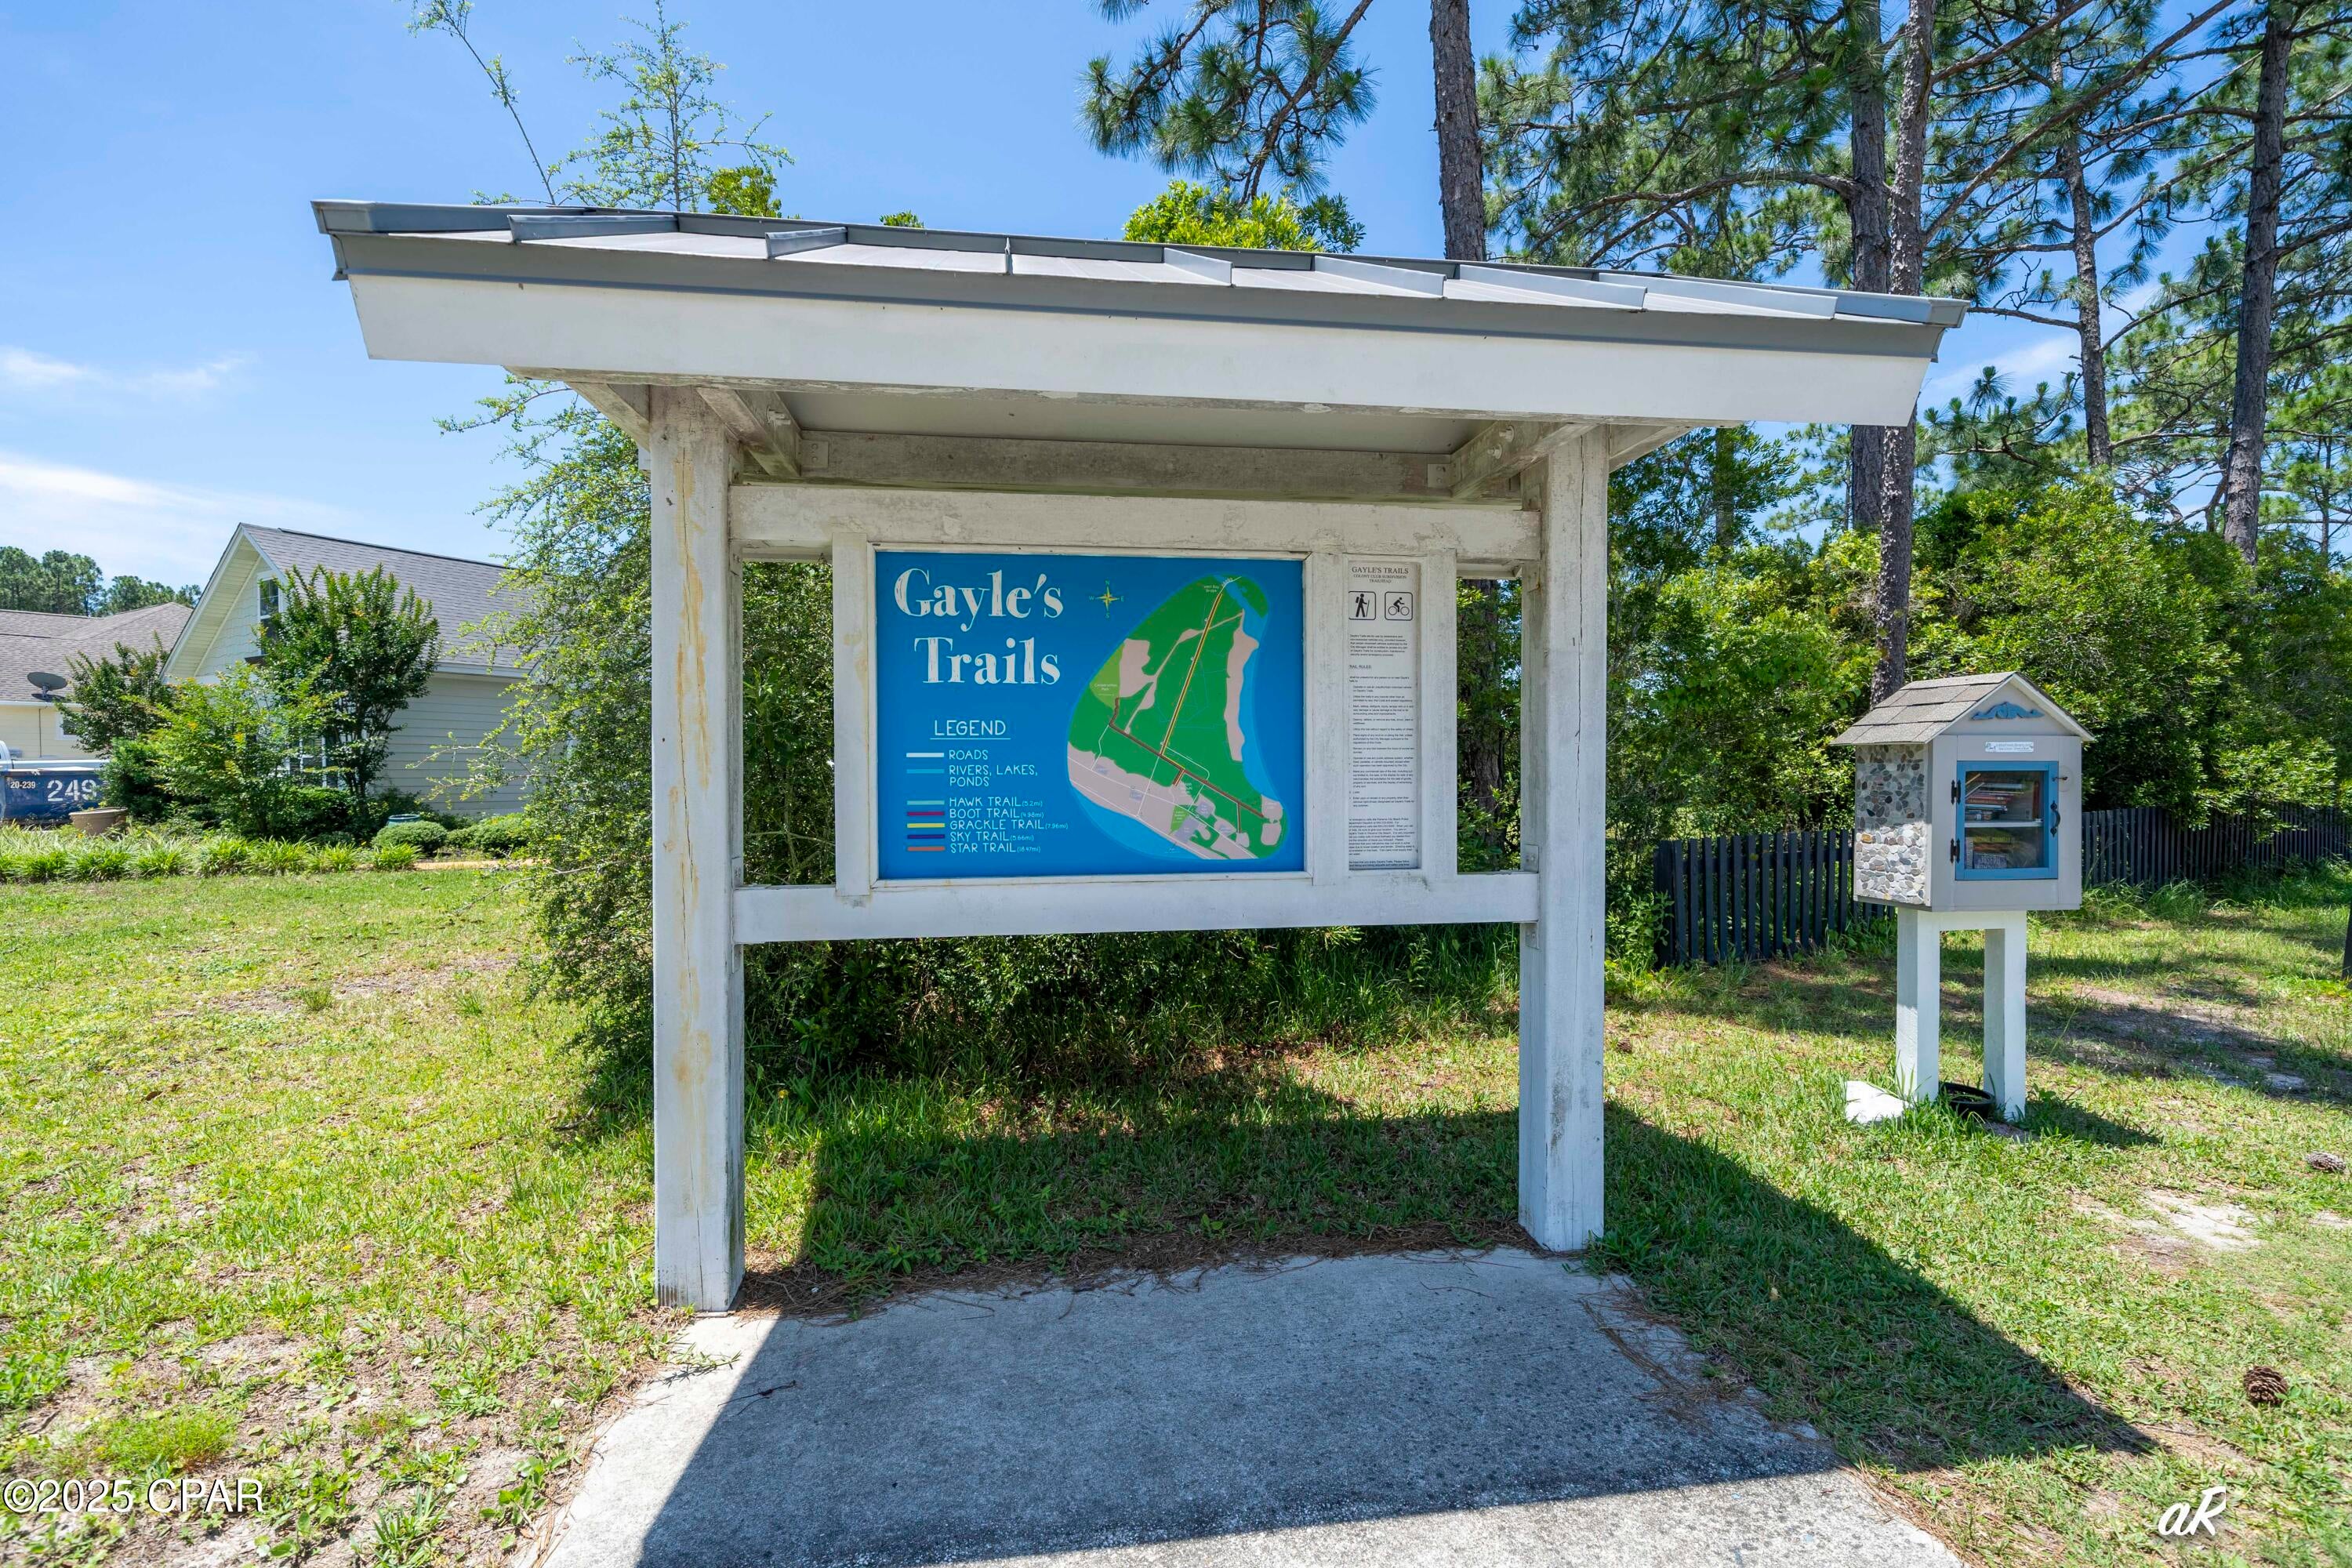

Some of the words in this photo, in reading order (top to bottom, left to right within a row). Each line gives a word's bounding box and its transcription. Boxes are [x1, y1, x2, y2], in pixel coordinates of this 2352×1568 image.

[894, 568, 1064, 632] Gayle's
[913, 637, 1061, 685] Trails
[934, 720, 1007, 737] LEGEND
[949, 750, 989, 760] ROADS
[949, 764, 992, 777] RIVERS,
[996, 764, 1038, 777] LAKES,
[949, 776, 989, 787] PONDS
[46, 779, 97, 802] 249
[949, 797, 983, 808] HAWK
[987, 797, 1022, 807] TRAIL
[949, 808, 982, 818] BOOT
[986, 808, 1020, 818] TRAIL
[949, 819, 1007, 830] GRACKLE
[1011, 819, 1045, 829] TRAIL
[949, 831, 971, 843] SKY
[975, 831, 1009, 841] TRAIL
[950, 843, 978, 854] STAR
[982, 843, 1016, 853] TRAIL
